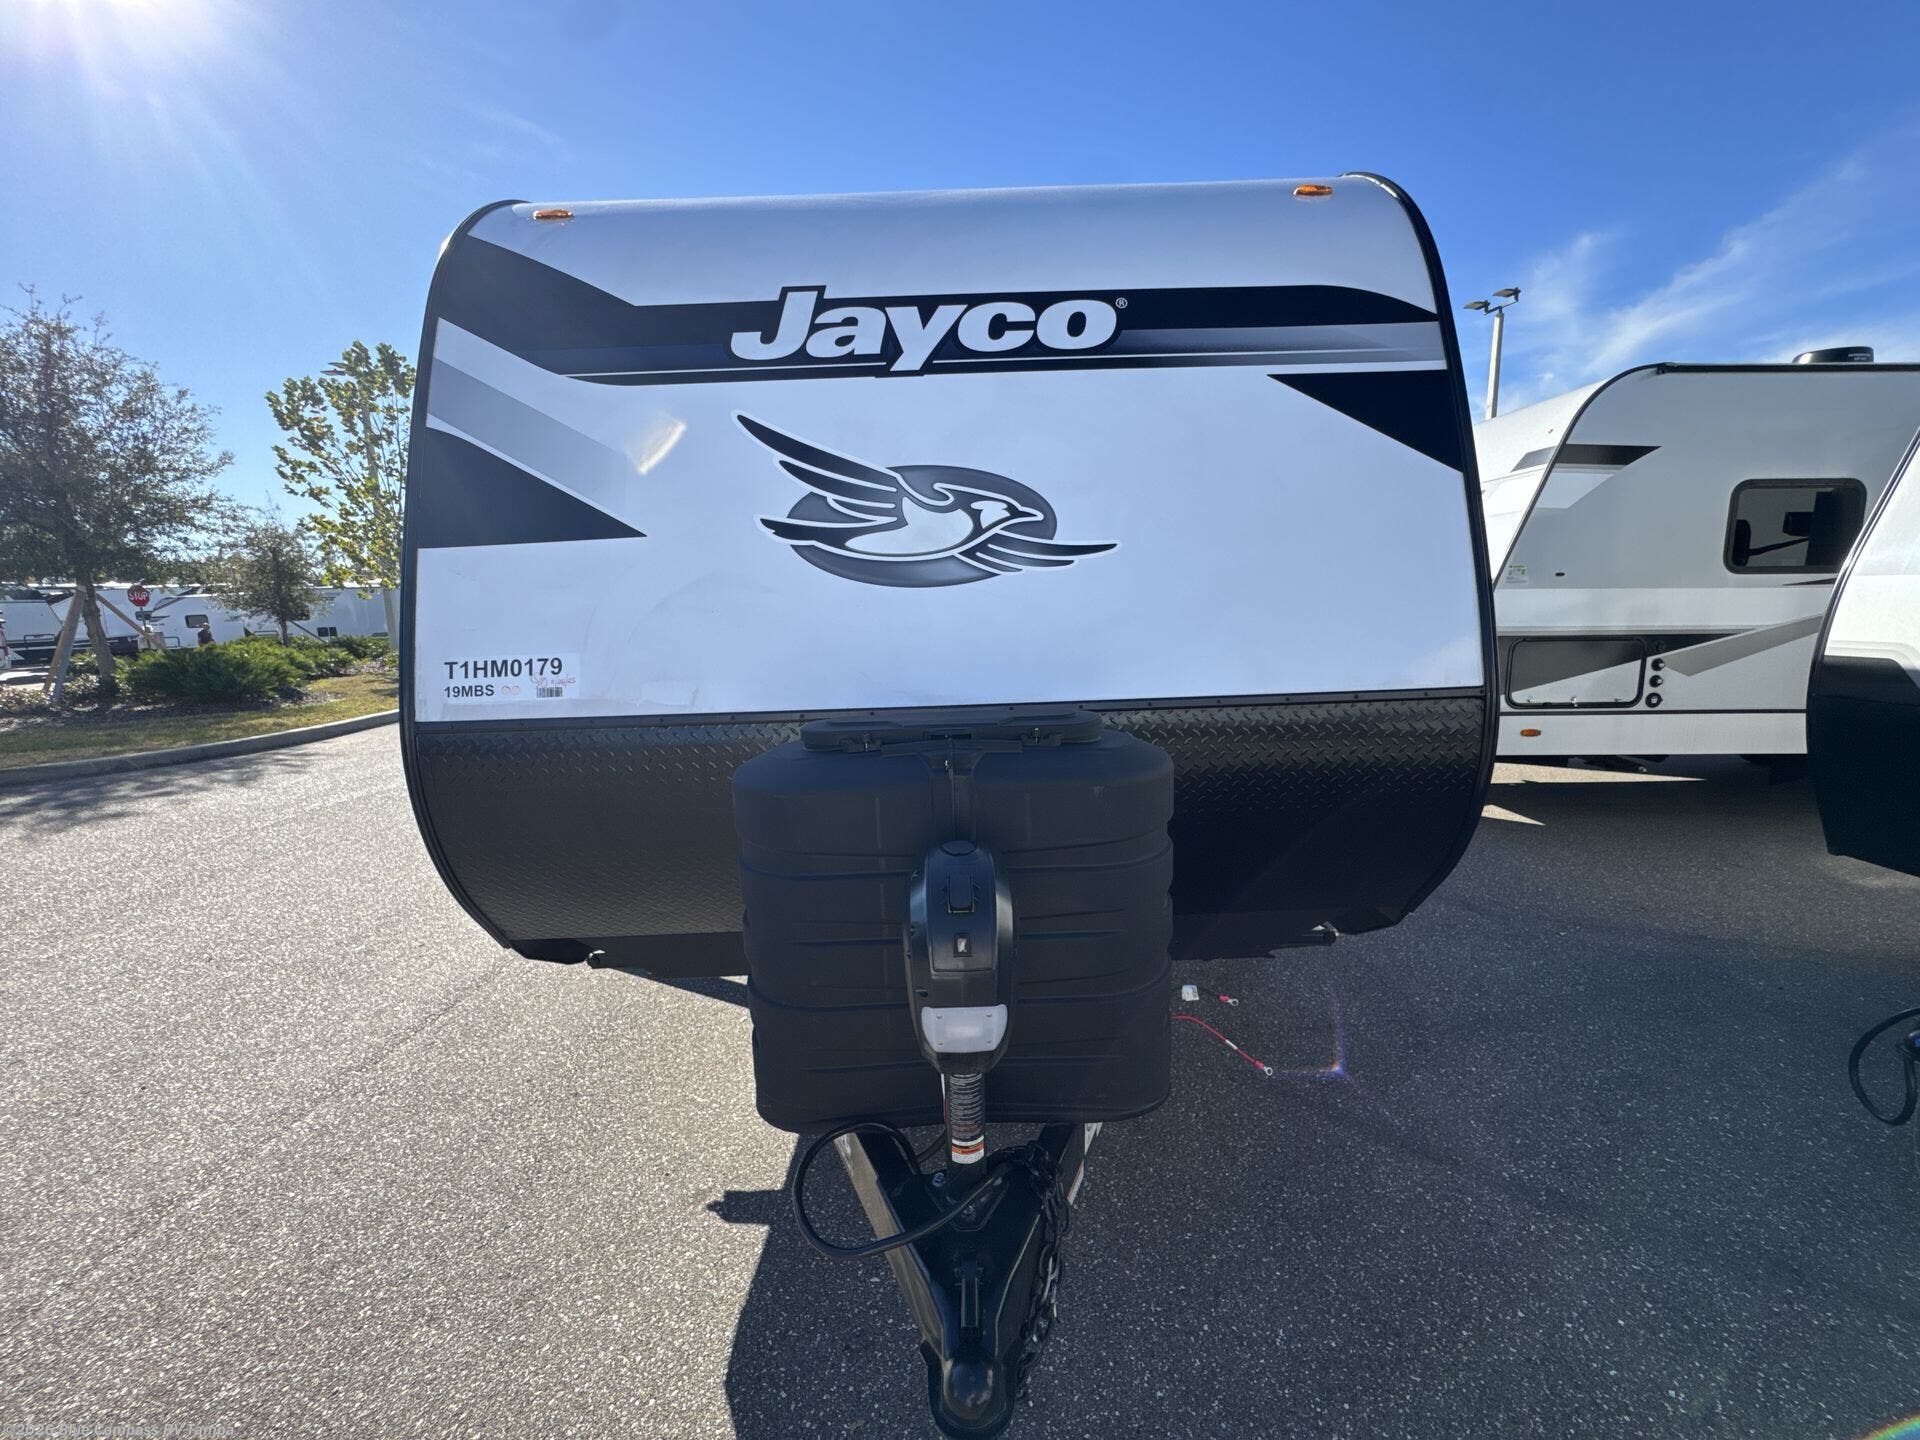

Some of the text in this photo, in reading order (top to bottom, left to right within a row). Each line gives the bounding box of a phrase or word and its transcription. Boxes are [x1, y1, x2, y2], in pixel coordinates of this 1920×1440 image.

[730, 290, 1118, 372] Jayco
[128, 592, 148, 600] STOP
[444, 657, 562, 679] T1HM0179
[444, 684, 495, 698] 19MBS
